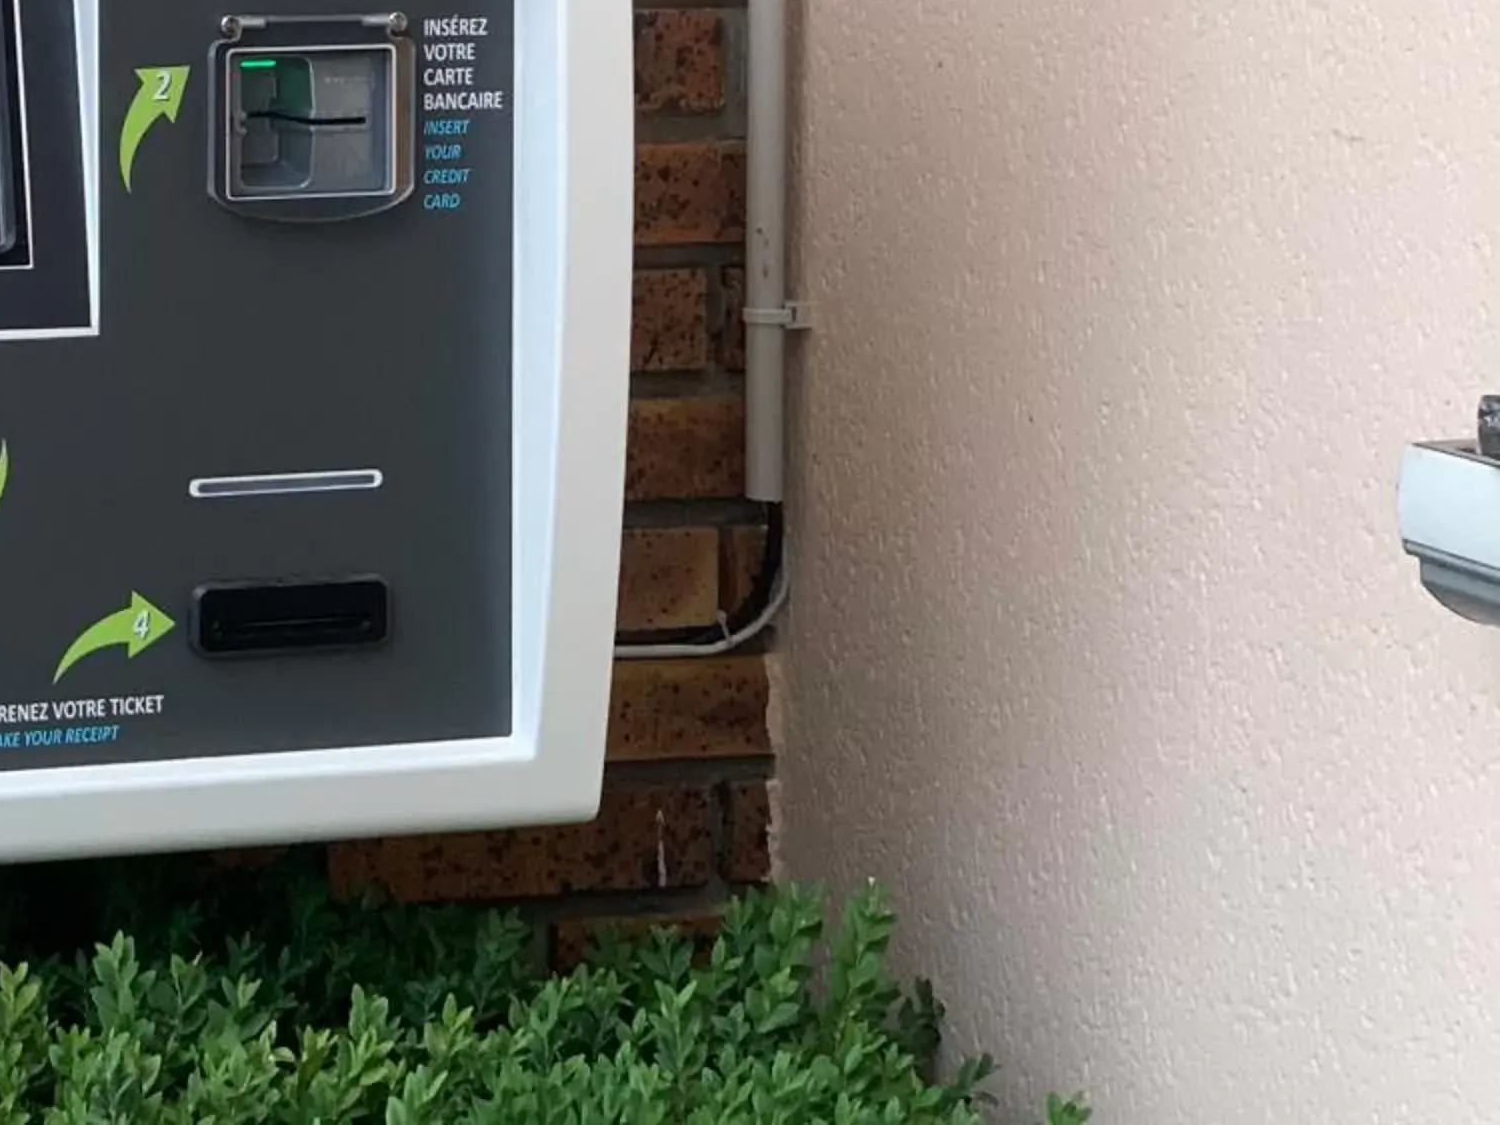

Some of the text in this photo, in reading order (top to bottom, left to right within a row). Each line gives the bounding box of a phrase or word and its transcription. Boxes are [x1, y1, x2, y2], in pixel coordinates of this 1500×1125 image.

[424, 15, 488, 36] INSÉREZ
[423, 43, 476, 62] VOTRE
[150, 69, 171, 102] 2
[423, 67, 474, 86] CARTE
[423, 91, 504, 111] BANCAIRE
[424, 118, 471, 135] INSERT
[425, 144, 462, 160] YOUR
[424, 169, 471, 184] CREDIT
[424, 193, 461, 209] CARD
[132, 609, 150, 640] 4
[52, 698, 106, 720] VOTRE
[109, 695, 165, 716] TICKET
[24, 729, 61, 747] YOUR
[65, 725, 120, 744] RECEIPT
